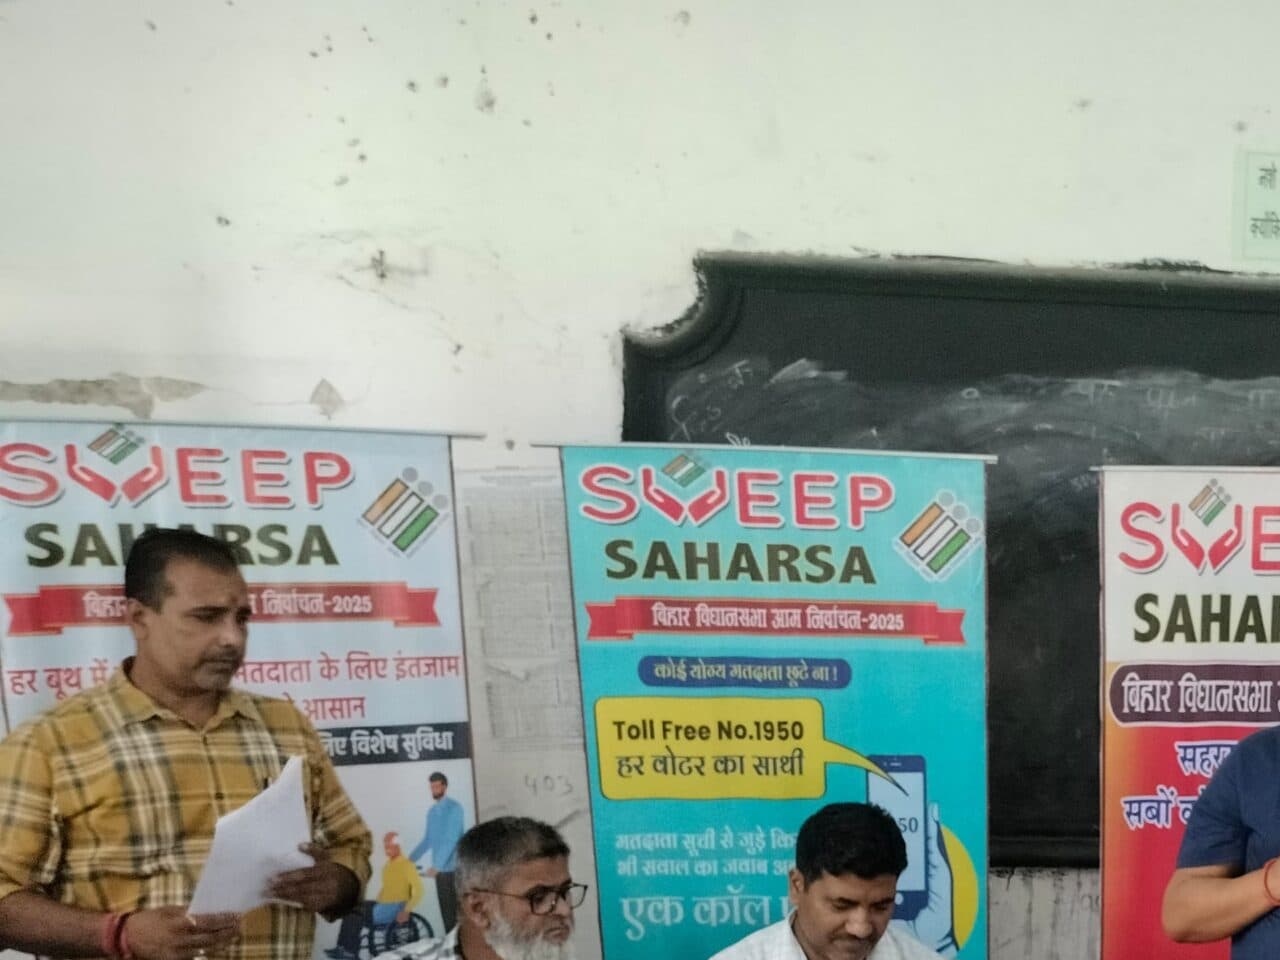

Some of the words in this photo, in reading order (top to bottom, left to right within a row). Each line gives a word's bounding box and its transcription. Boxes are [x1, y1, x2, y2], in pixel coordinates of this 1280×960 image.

[0, 441, 355, 507] SWEEP
[581, 466, 895, 529] SWEEP
[24, 523, 339, 567] SARSA
[605, 540, 877, 585] SAHARSA
[652, 602, 690, 627] बिहार
[696, 603, 767, 628] विधानसभा
[772, 607, 801, 628] आम
[318, 656, 340, 680] के
[347, 653, 387, 680] लिए
[655, 658, 686, 681] कोई
[690, 659, 725, 680] योग्य
[730, 664, 782, 682] मतदाता
[8, 670, 37, 694] हर
[44, 667, 82, 700] बूथ
[1122, 672, 1173, 713] बिहार
[1178, 672, 1273, 713] विधानसभा
[350, 729, 398, 755] विशेष
[402, 726, 453, 759] सुविधा
[613, 720, 655, 740] Toll
[662, 720, 711, 741] Free
[719, 720, 804, 741] No.1950
[616, 755, 644, 777] हर
[653, 745, 705, 777] वोटर
[714, 754, 744, 775] का
[753, 749, 804, 777] साथी
[615, 833, 676, 850] मतदाता
[682, 828, 715, 856] सूची
[720, 825, 734, 849] से
[617, 856, 638, 876] भी
[642, 858, 689, 876] सवाल
[694, 858, 717, 876] का
[723, 858, 767, 875] जवाब
[620, 896, 684, 941] एक
[692, 884, 771, 926] कॉल
